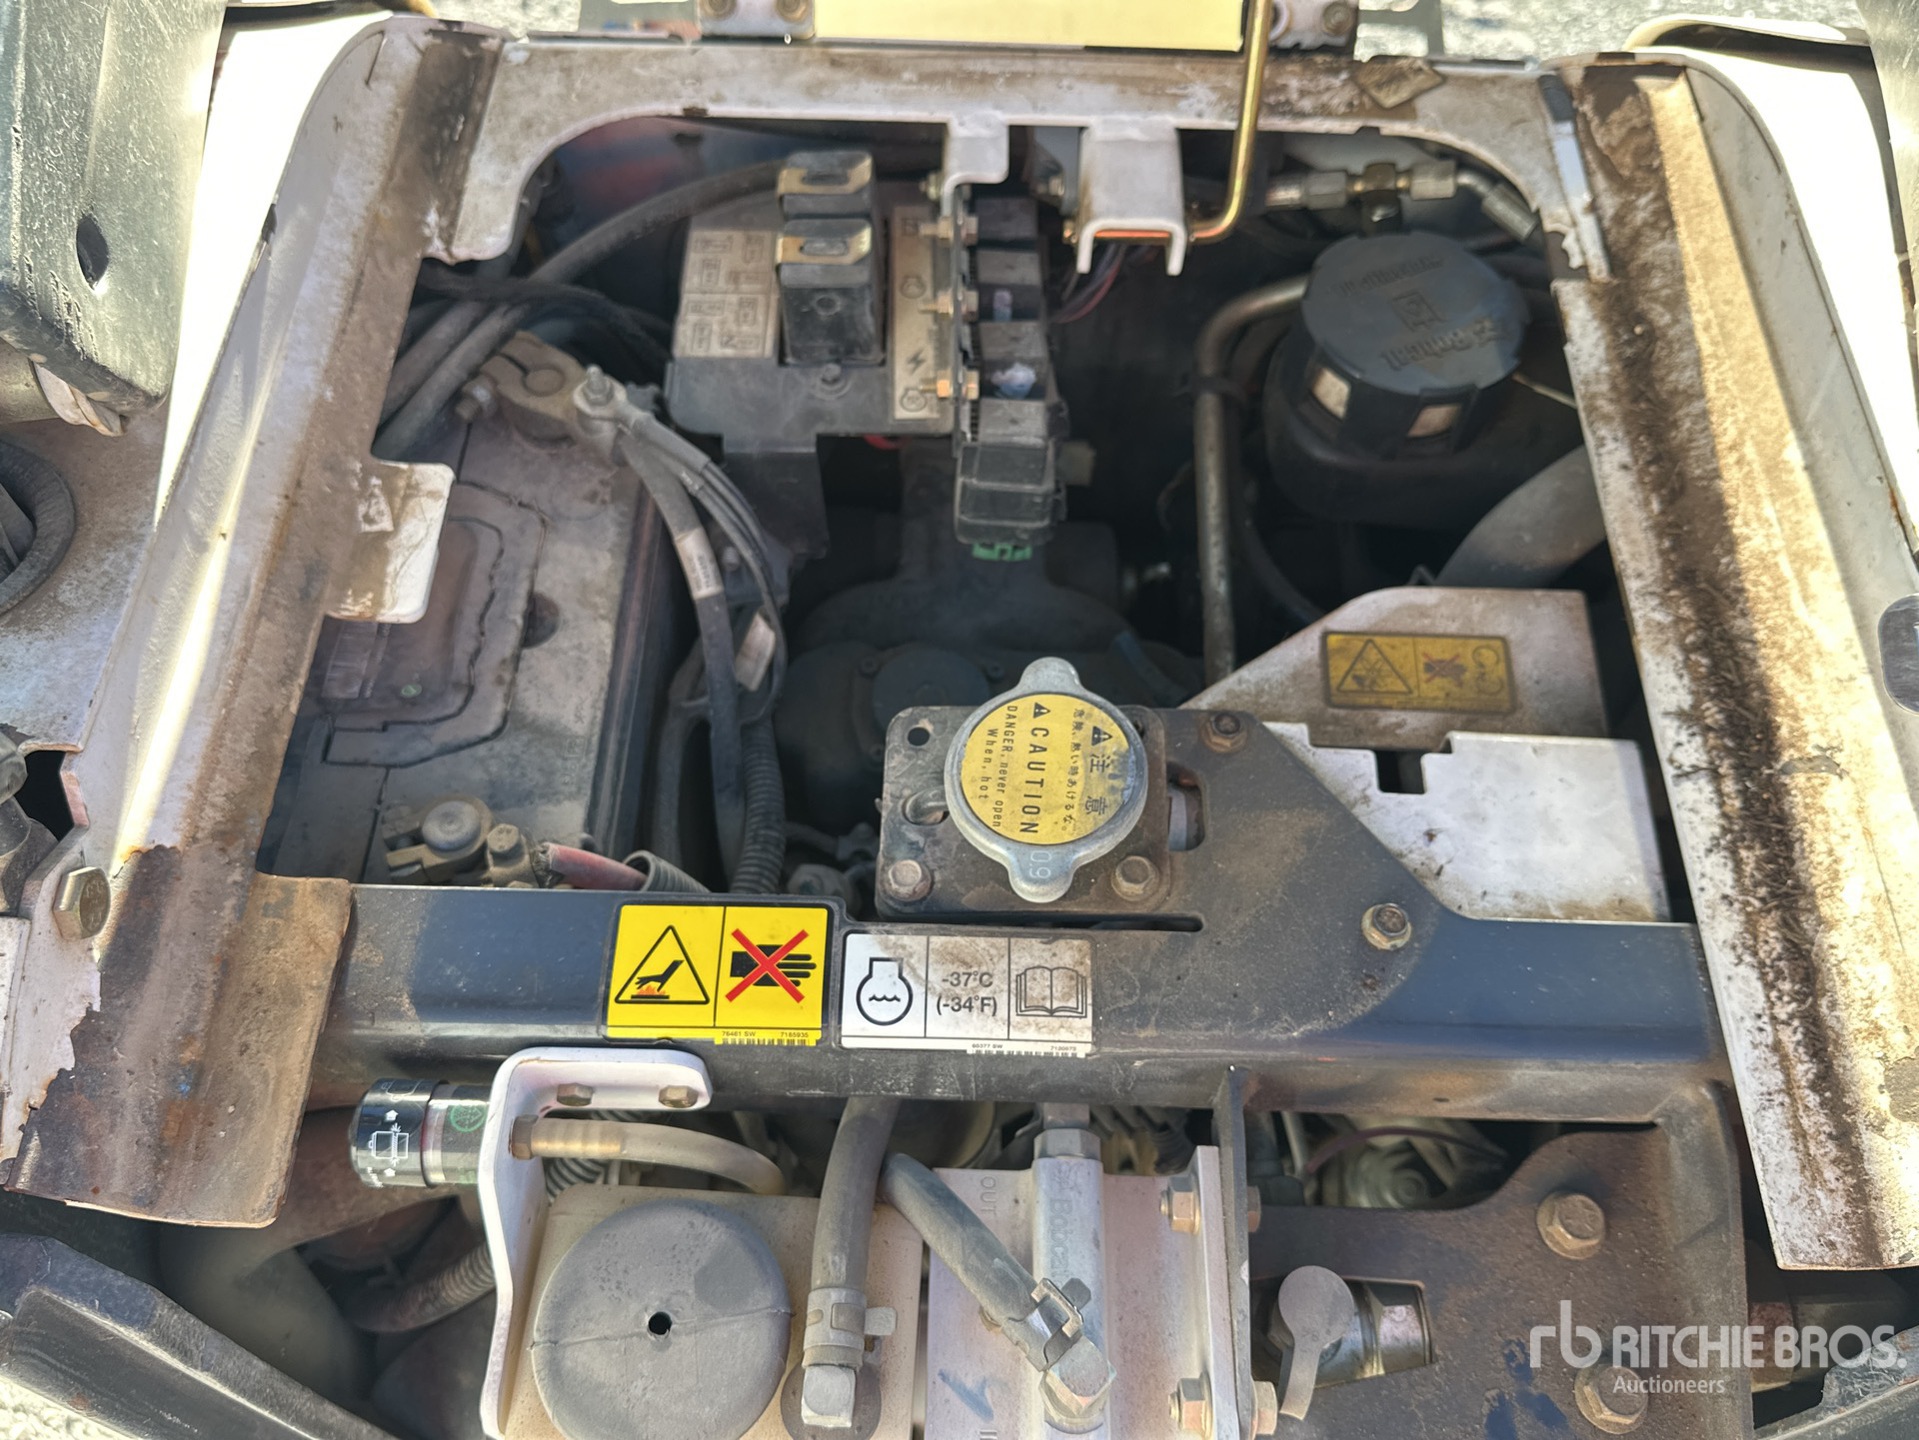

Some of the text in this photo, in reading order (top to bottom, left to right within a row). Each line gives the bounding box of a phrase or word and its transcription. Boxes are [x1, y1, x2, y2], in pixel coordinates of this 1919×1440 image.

[979, 775, 993, 801] hot
[996, 761, 1009, 795] never
[1019, 726, 1050, 834] CAUTION
[992, 799, 1004, 828] open
[1029, 850, 1051, 879] 0.9
[941, 971, 993, 988] -37°C
[936, 996, 998, 1017] (-34°F)
[981, 1176, 997, 1215] OUT
